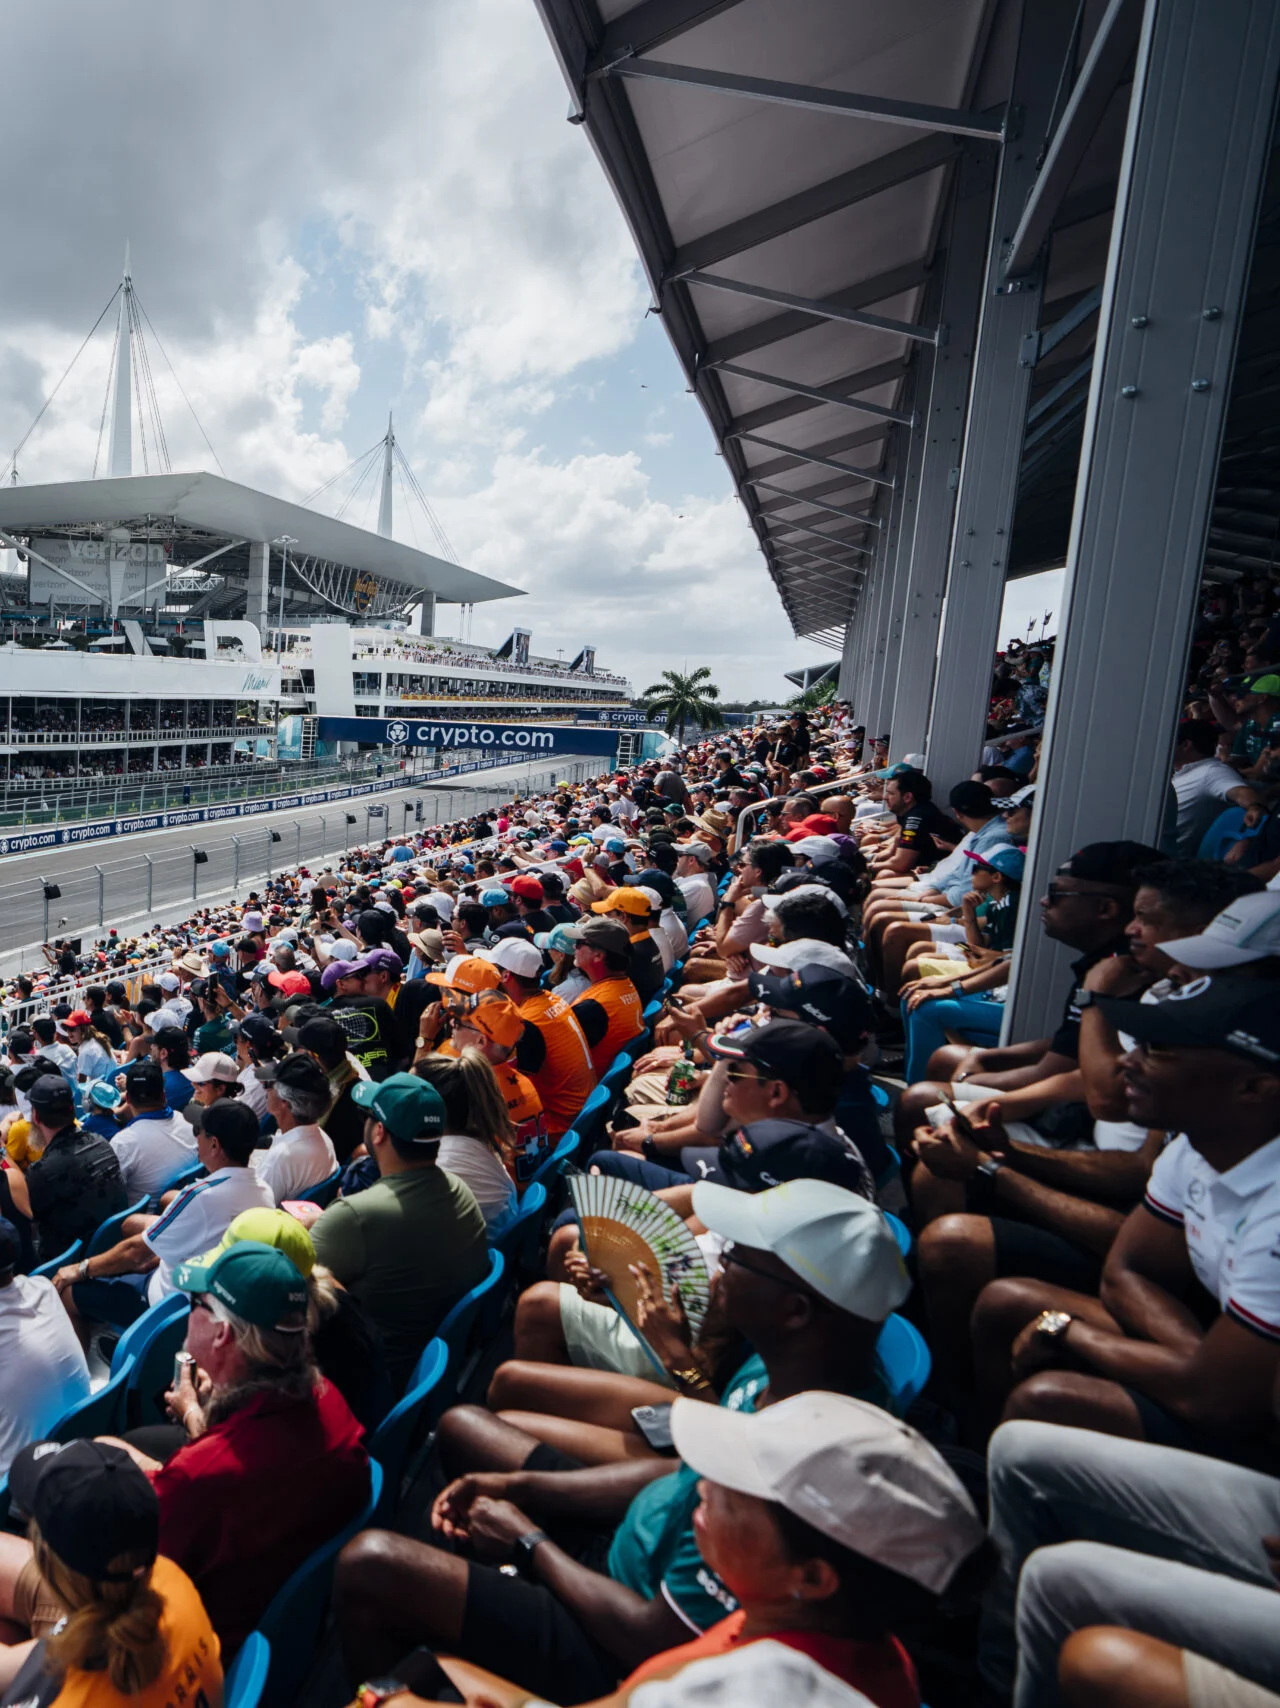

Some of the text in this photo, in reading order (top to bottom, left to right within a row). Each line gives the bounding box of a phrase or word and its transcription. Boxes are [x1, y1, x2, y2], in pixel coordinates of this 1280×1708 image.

[242, 672, 272, 693] Miami
[611, 712, 668, 722] crypto.om
[416, 723, 554, 748] crypto.com
[277, 798, 299, 808] crypto.com
[305, 794, 325, 803] crypto.com
[209, 806, 236, 818] crypto.com
[244, 802, 269, 813] crypto.com
[123, 818, 157, 831] crypto.com
[170, 811, 199, 825] crypto.com
[71, 825, 110, 840] crypto.com
[10, 833, 55, 850] crypto.com
